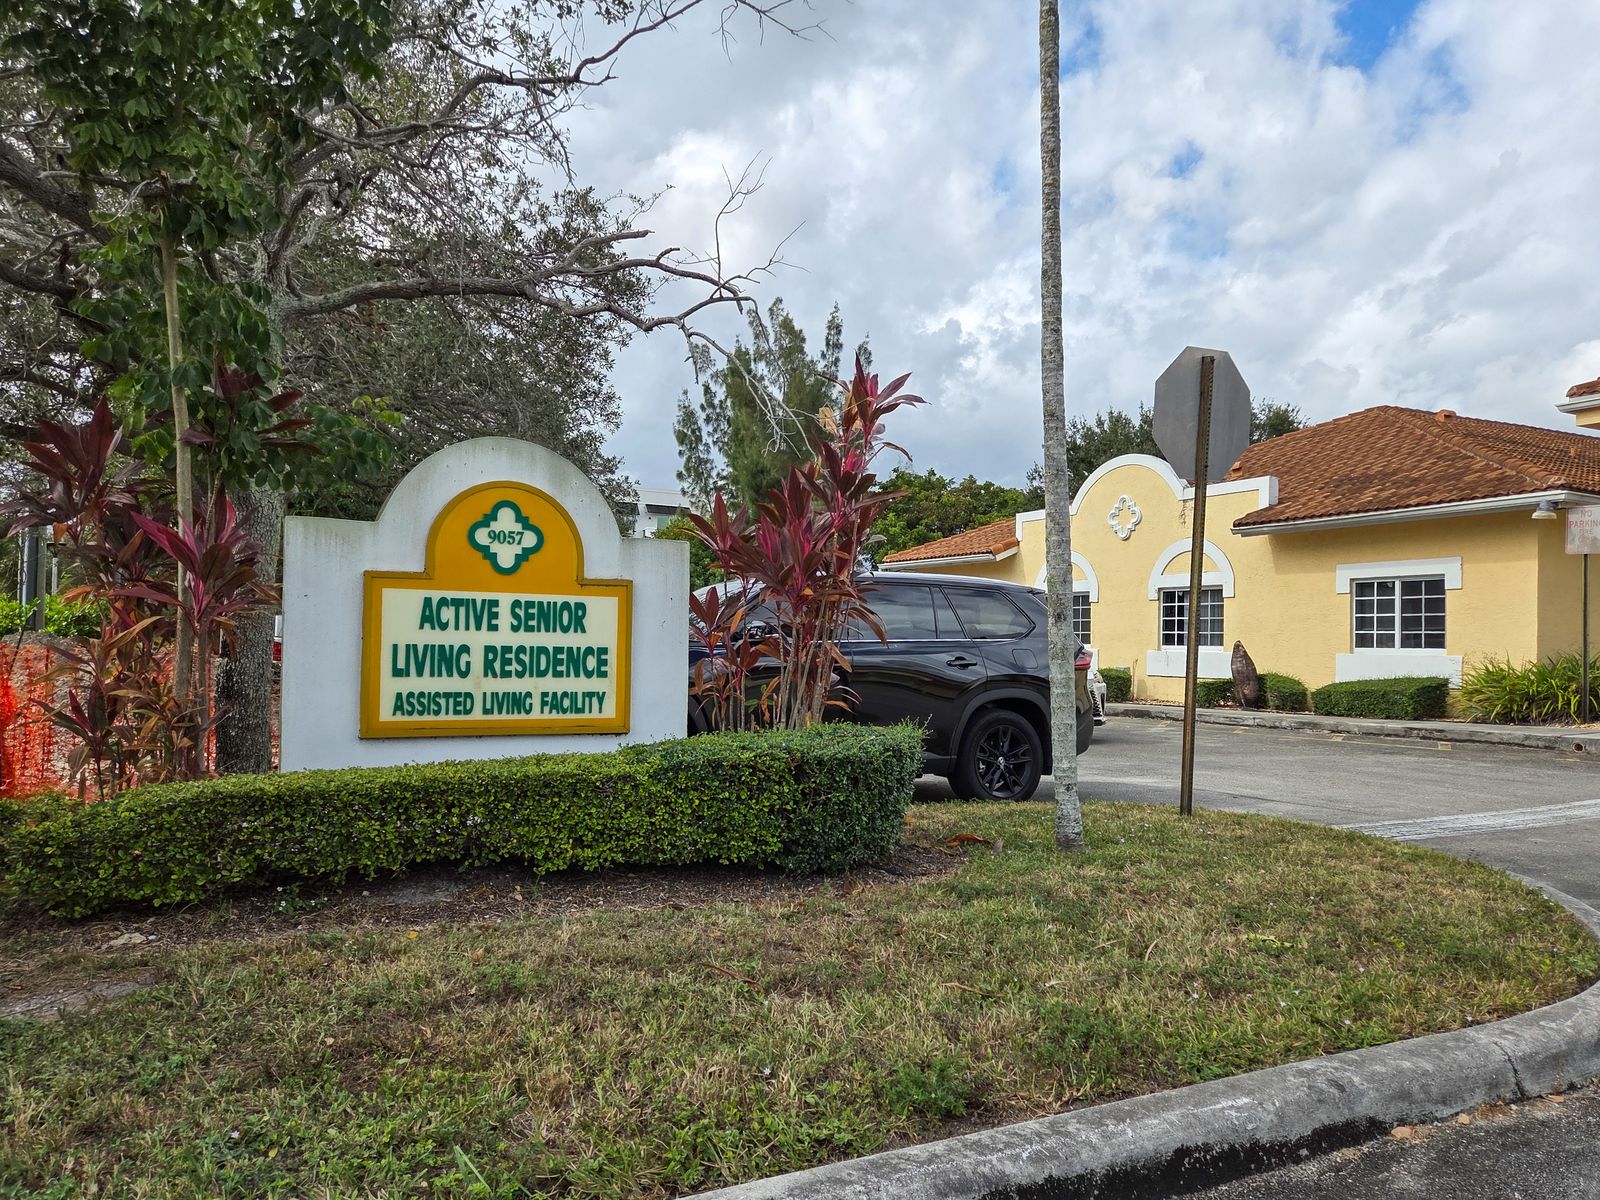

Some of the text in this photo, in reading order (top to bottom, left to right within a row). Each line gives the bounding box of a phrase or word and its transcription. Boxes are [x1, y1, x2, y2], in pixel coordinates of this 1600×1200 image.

[1580, 509, 1593, 518] NO
[1568, 520, 1600, 528] PARKIN
[488, 529, 525, 545] 9057
[419, 597, 587, 634] ACTIVE SENIOR
[392, 643, 608, 679] LIVING RESIDENCE
[392, 691, 606, 716] ASSISTED LIVING FACILITY
